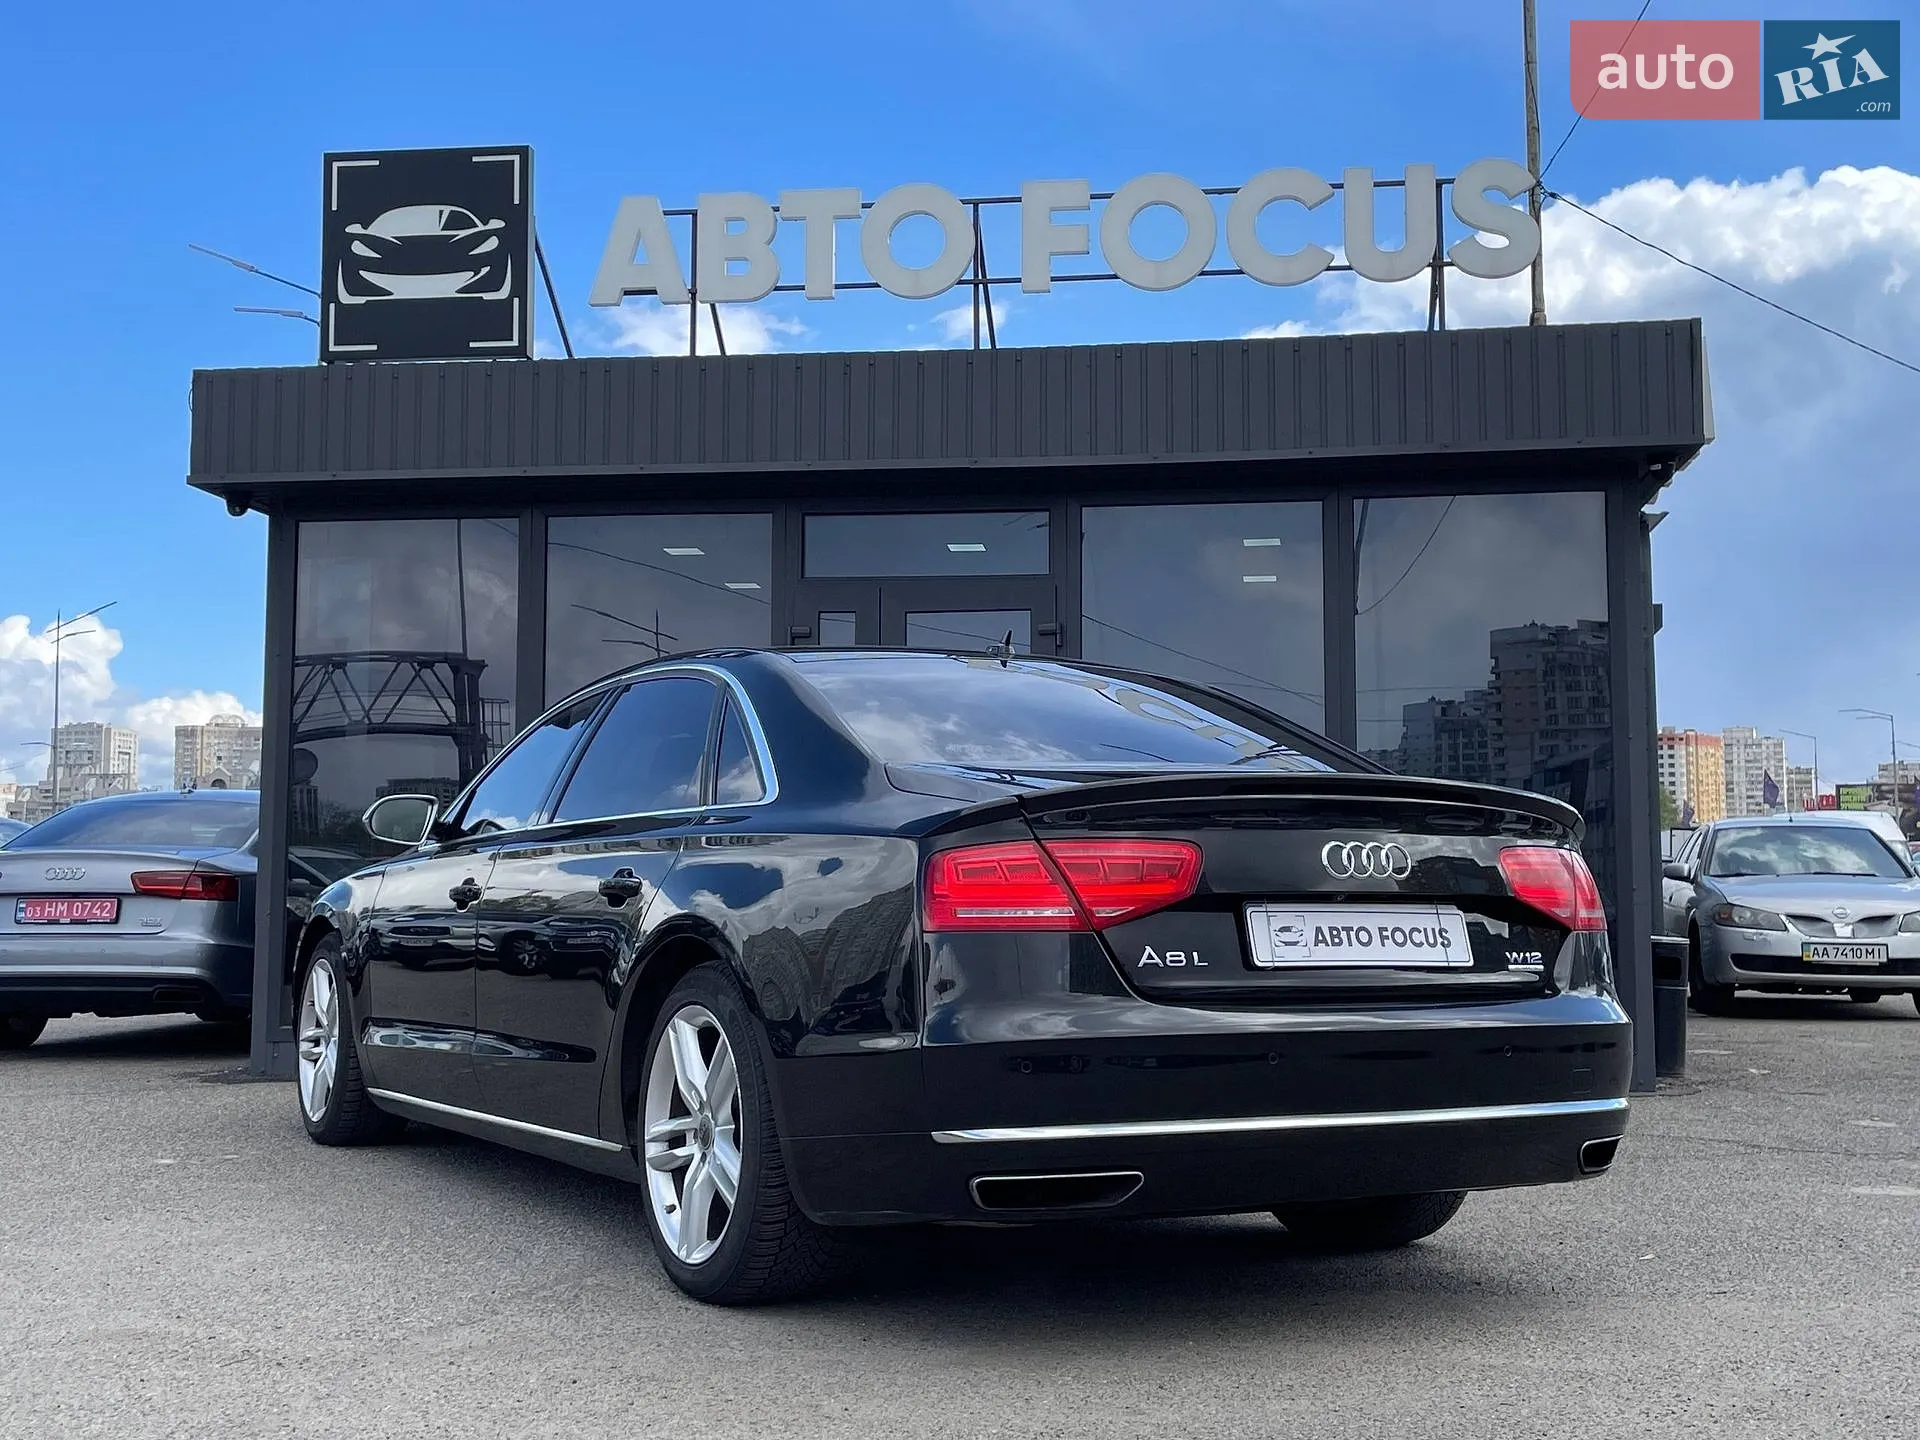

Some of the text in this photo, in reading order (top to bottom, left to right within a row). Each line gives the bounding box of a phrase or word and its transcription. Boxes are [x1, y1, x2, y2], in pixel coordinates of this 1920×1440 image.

[1020, 157, 1542, 294] FOCUS
[26, 900, 111, 917] 03 HM 0742
[1378, 926, 1452, 949] FOCUS
[1505, 951, 1543, 964] W12
[1812, 946, 1881, 959] AA 7410 MI
